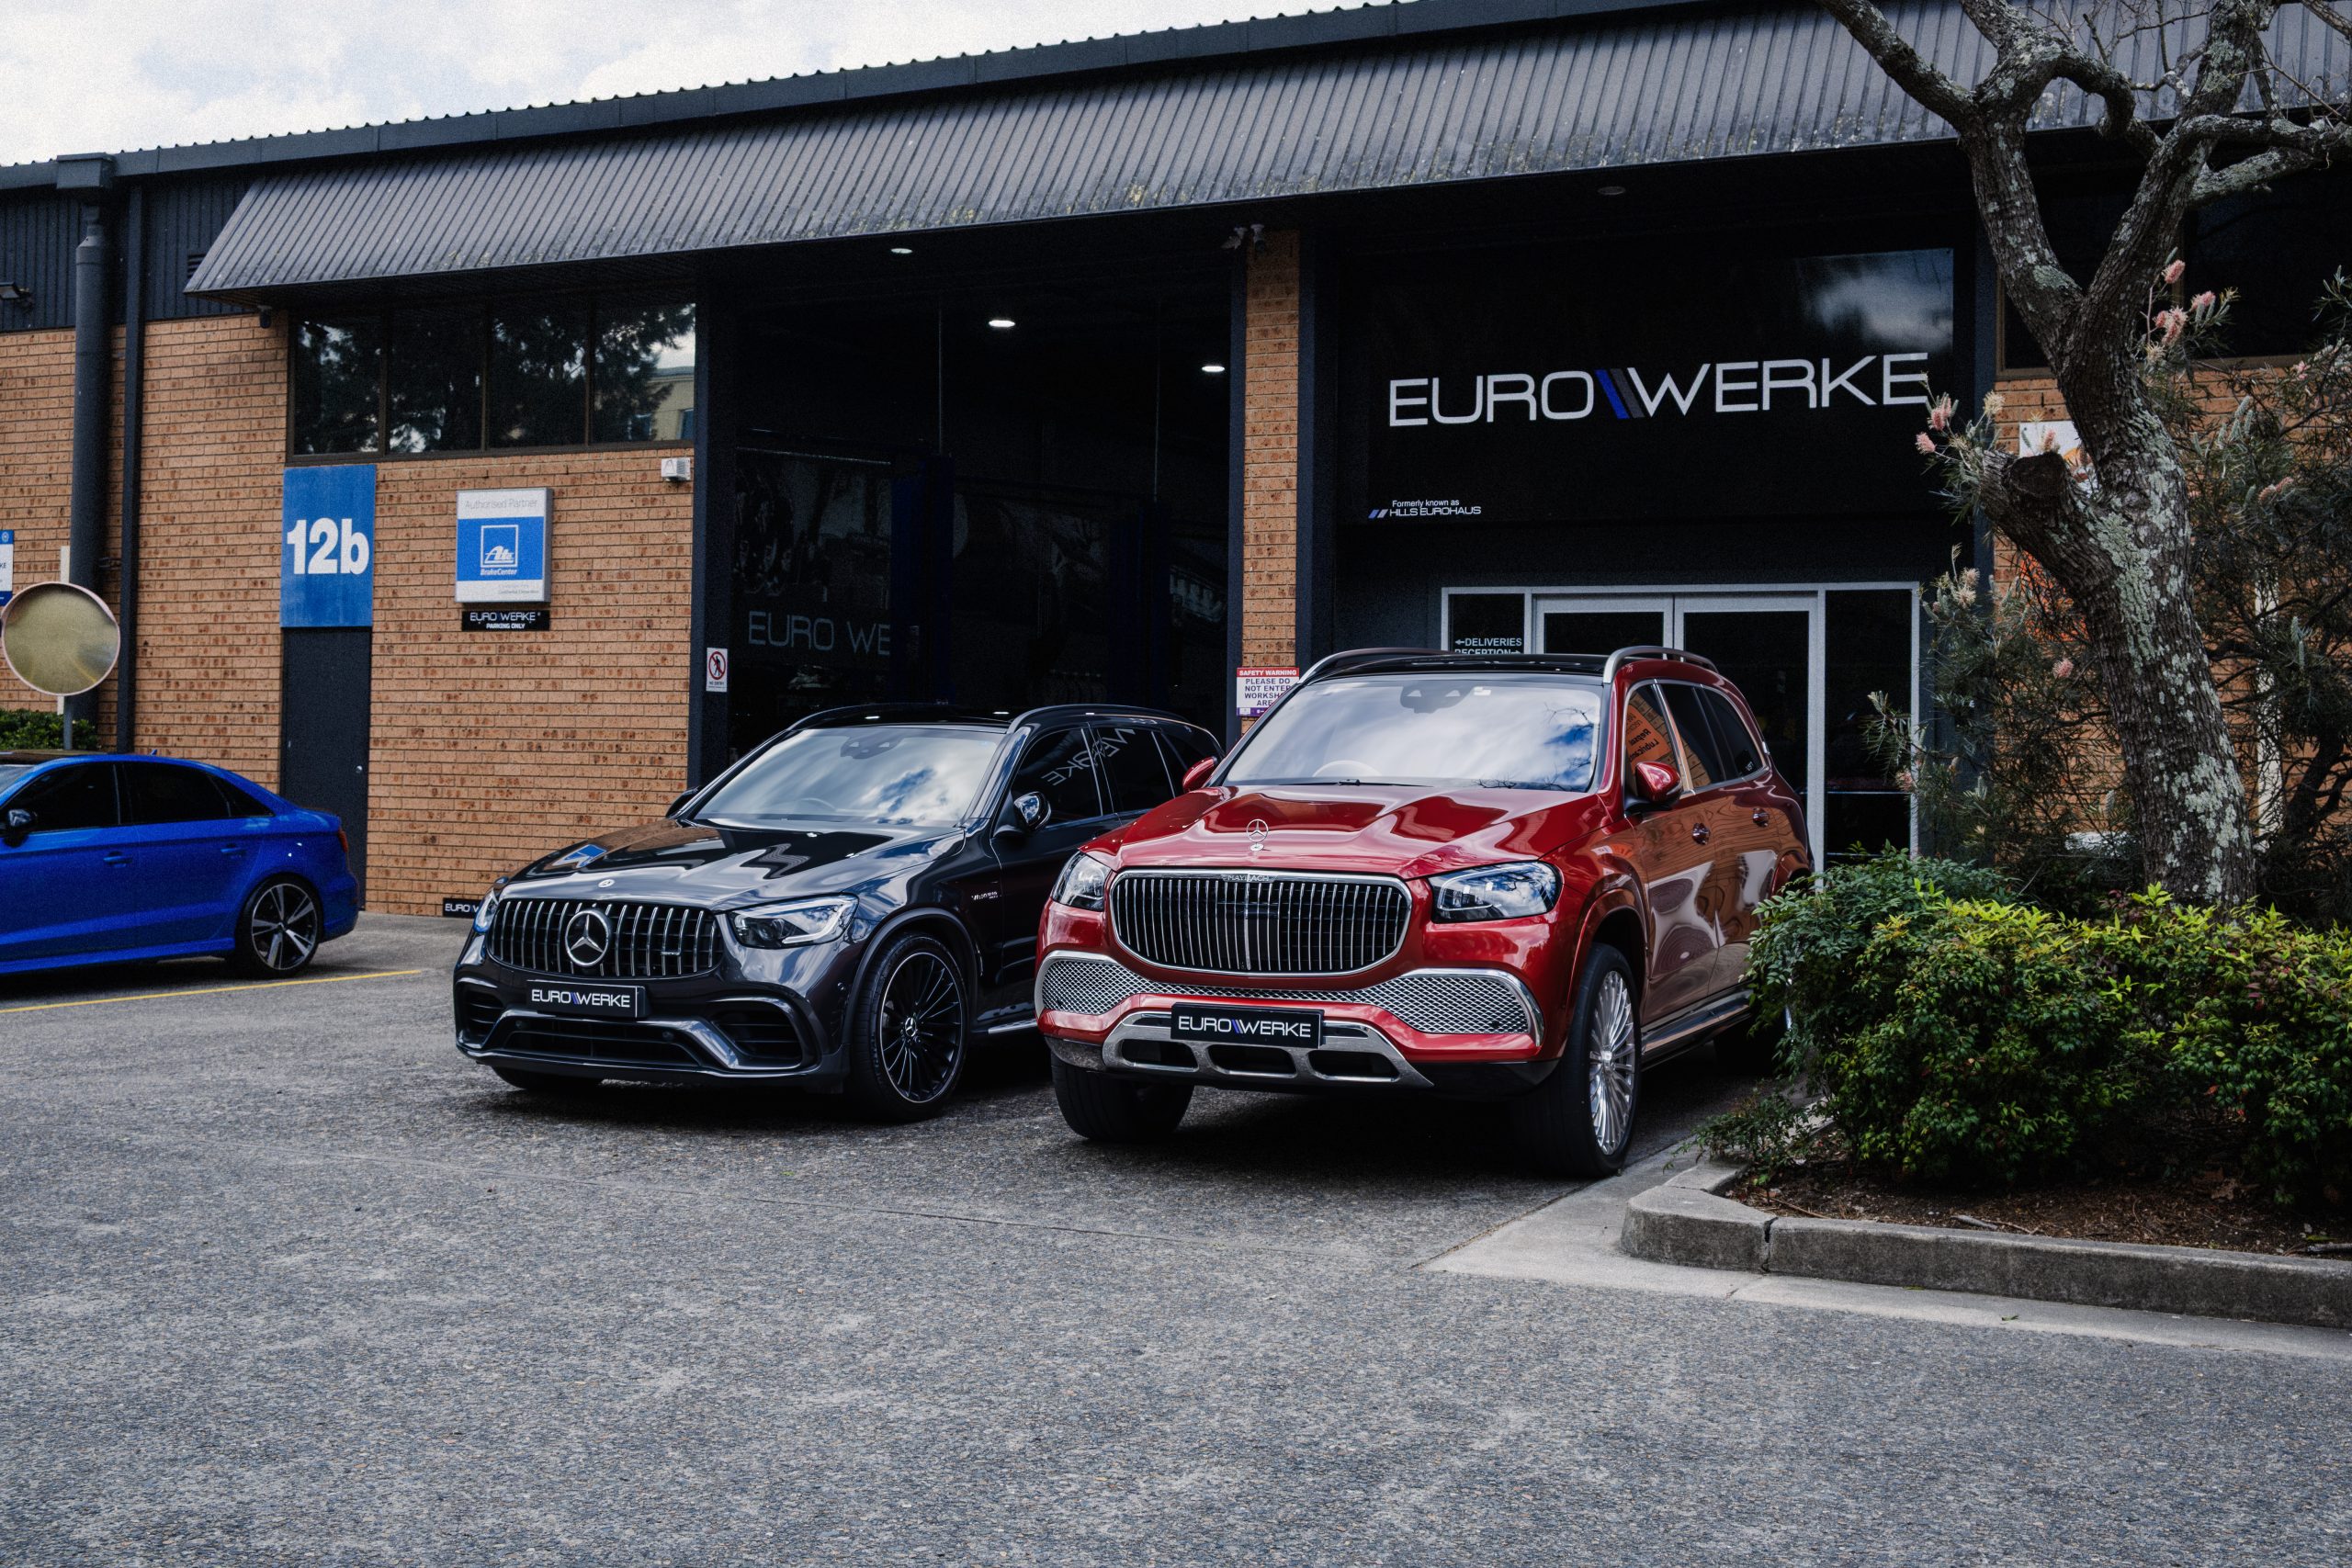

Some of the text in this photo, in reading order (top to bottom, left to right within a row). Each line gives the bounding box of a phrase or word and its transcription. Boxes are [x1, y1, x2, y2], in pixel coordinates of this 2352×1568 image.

[465, 498, 537, 509] Authorised Partner
[1392, 500, 1424, 508] Formerly
[1389, 506, 1482, 516] HILLS EUROHAUS
[287, 517, 369, 575] 12b
[469, 612, 536, 622] EURO WERKE
[748, 610, 835, 651] EURO
[1464, 637, 1522, 647] DELIVERIES
[445, 903, 470, 913] EURO
